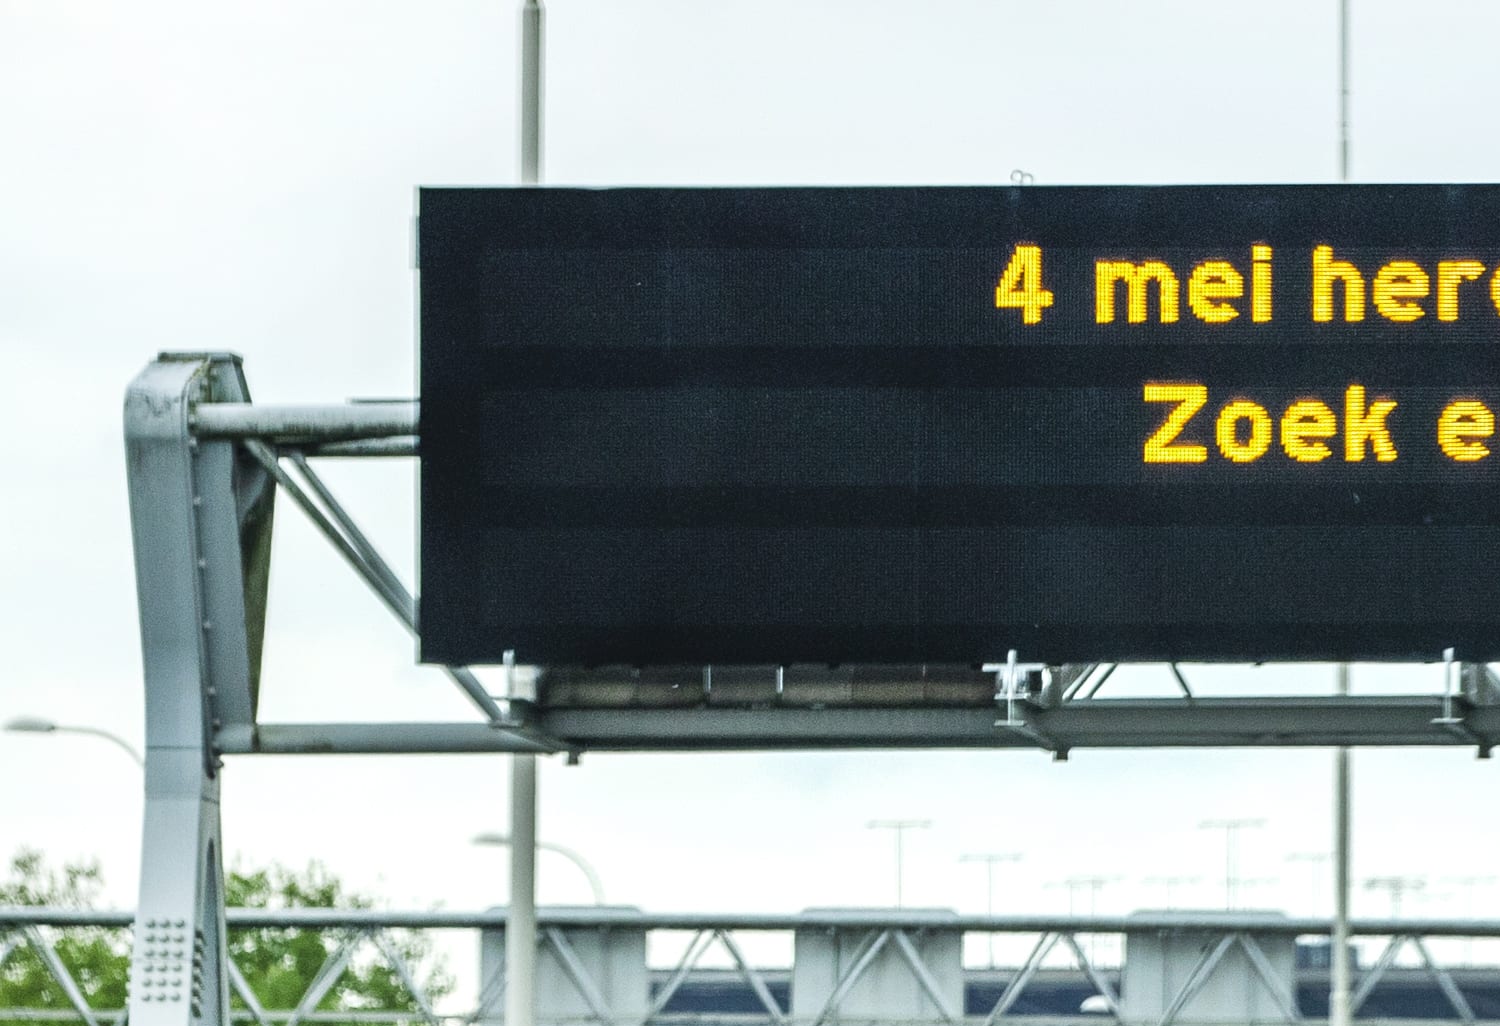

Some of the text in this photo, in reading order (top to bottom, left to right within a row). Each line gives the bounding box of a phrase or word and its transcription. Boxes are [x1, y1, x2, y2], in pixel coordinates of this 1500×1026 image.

[996, 245, 1053, 324] 4
[1096, 245, 1272, 323] mei
[1144, 383, 1397, 462] Zoek
